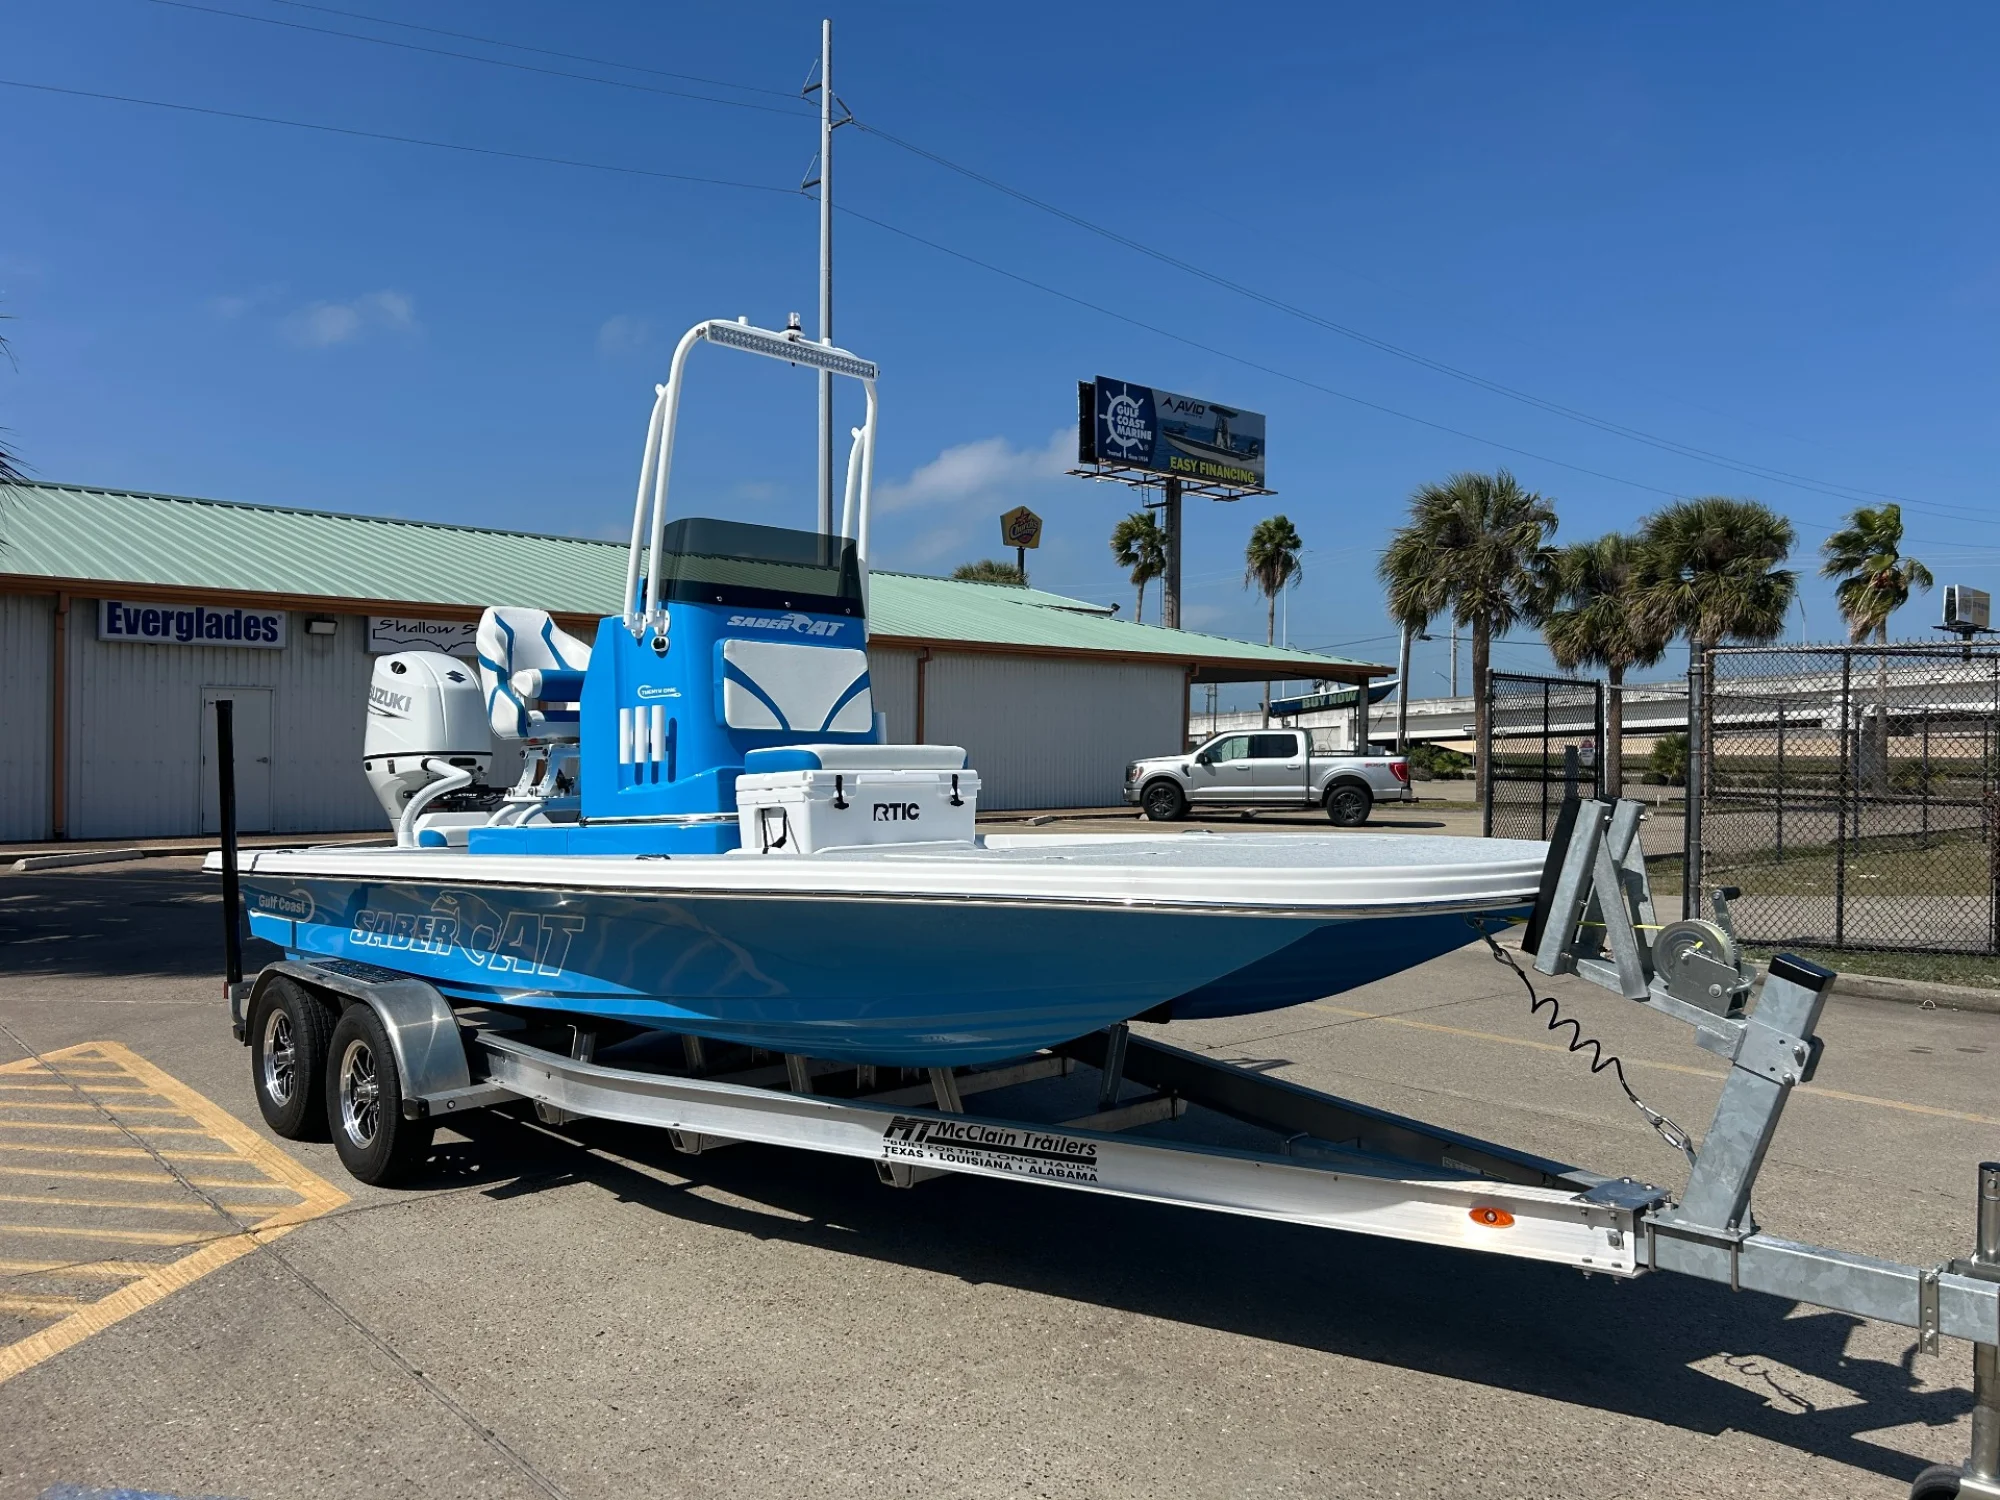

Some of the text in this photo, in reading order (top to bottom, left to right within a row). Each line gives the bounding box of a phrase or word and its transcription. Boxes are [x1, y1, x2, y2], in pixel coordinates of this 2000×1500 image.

[1116, 404, 1139, 418] GULF
[1173, 400, 1205, 416] AVID
[1116, 415, 1146, 430] COAST
[1117, 424, 1152, 441] MARINE
[1170, 456, 1256, 484] EASY FINANCING
[106, 601, 279, 643] Everglades
[379, 619, 456, 635] Shallow
[1302, 690, 1358, 710] BUY NOW
[873, 802, 920, 821] RTIC
[258, 894, 306, 914] Gulf Coast
[935, 1121, 1099, 1156] McClain Trailers
[883, 1145, 1099, 1183] TEXAS LOUISIANA ALABAMA
[927, 1144, 954, 1154] FOR
[956, 1147, 982, 1157] THE
[987, 1152, 1038, 1164] LONG
